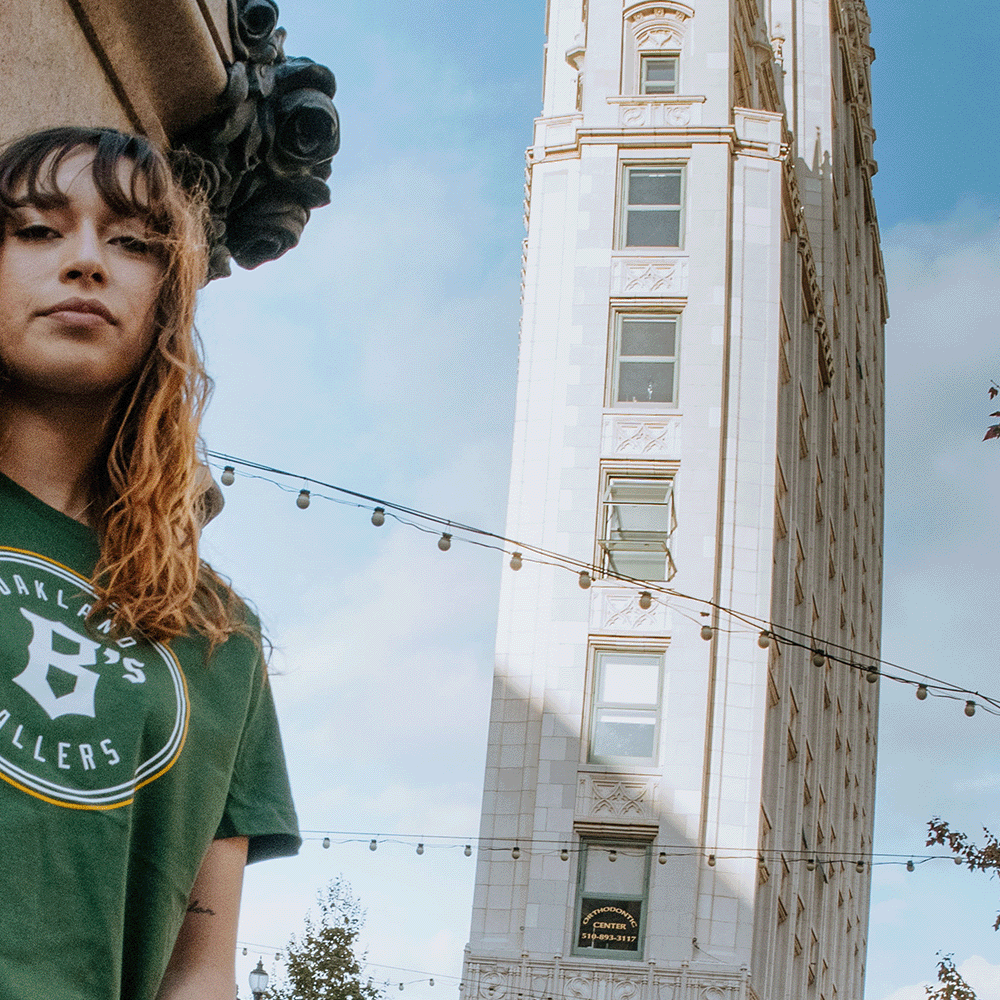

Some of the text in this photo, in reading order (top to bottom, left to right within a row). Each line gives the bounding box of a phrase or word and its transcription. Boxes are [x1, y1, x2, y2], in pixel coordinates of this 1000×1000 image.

[582, 906, 638, 928] ORTHODONTIC
[593, 921, 627, 930] CENTER
[581, 933, 637, 942] 510-893-3117
